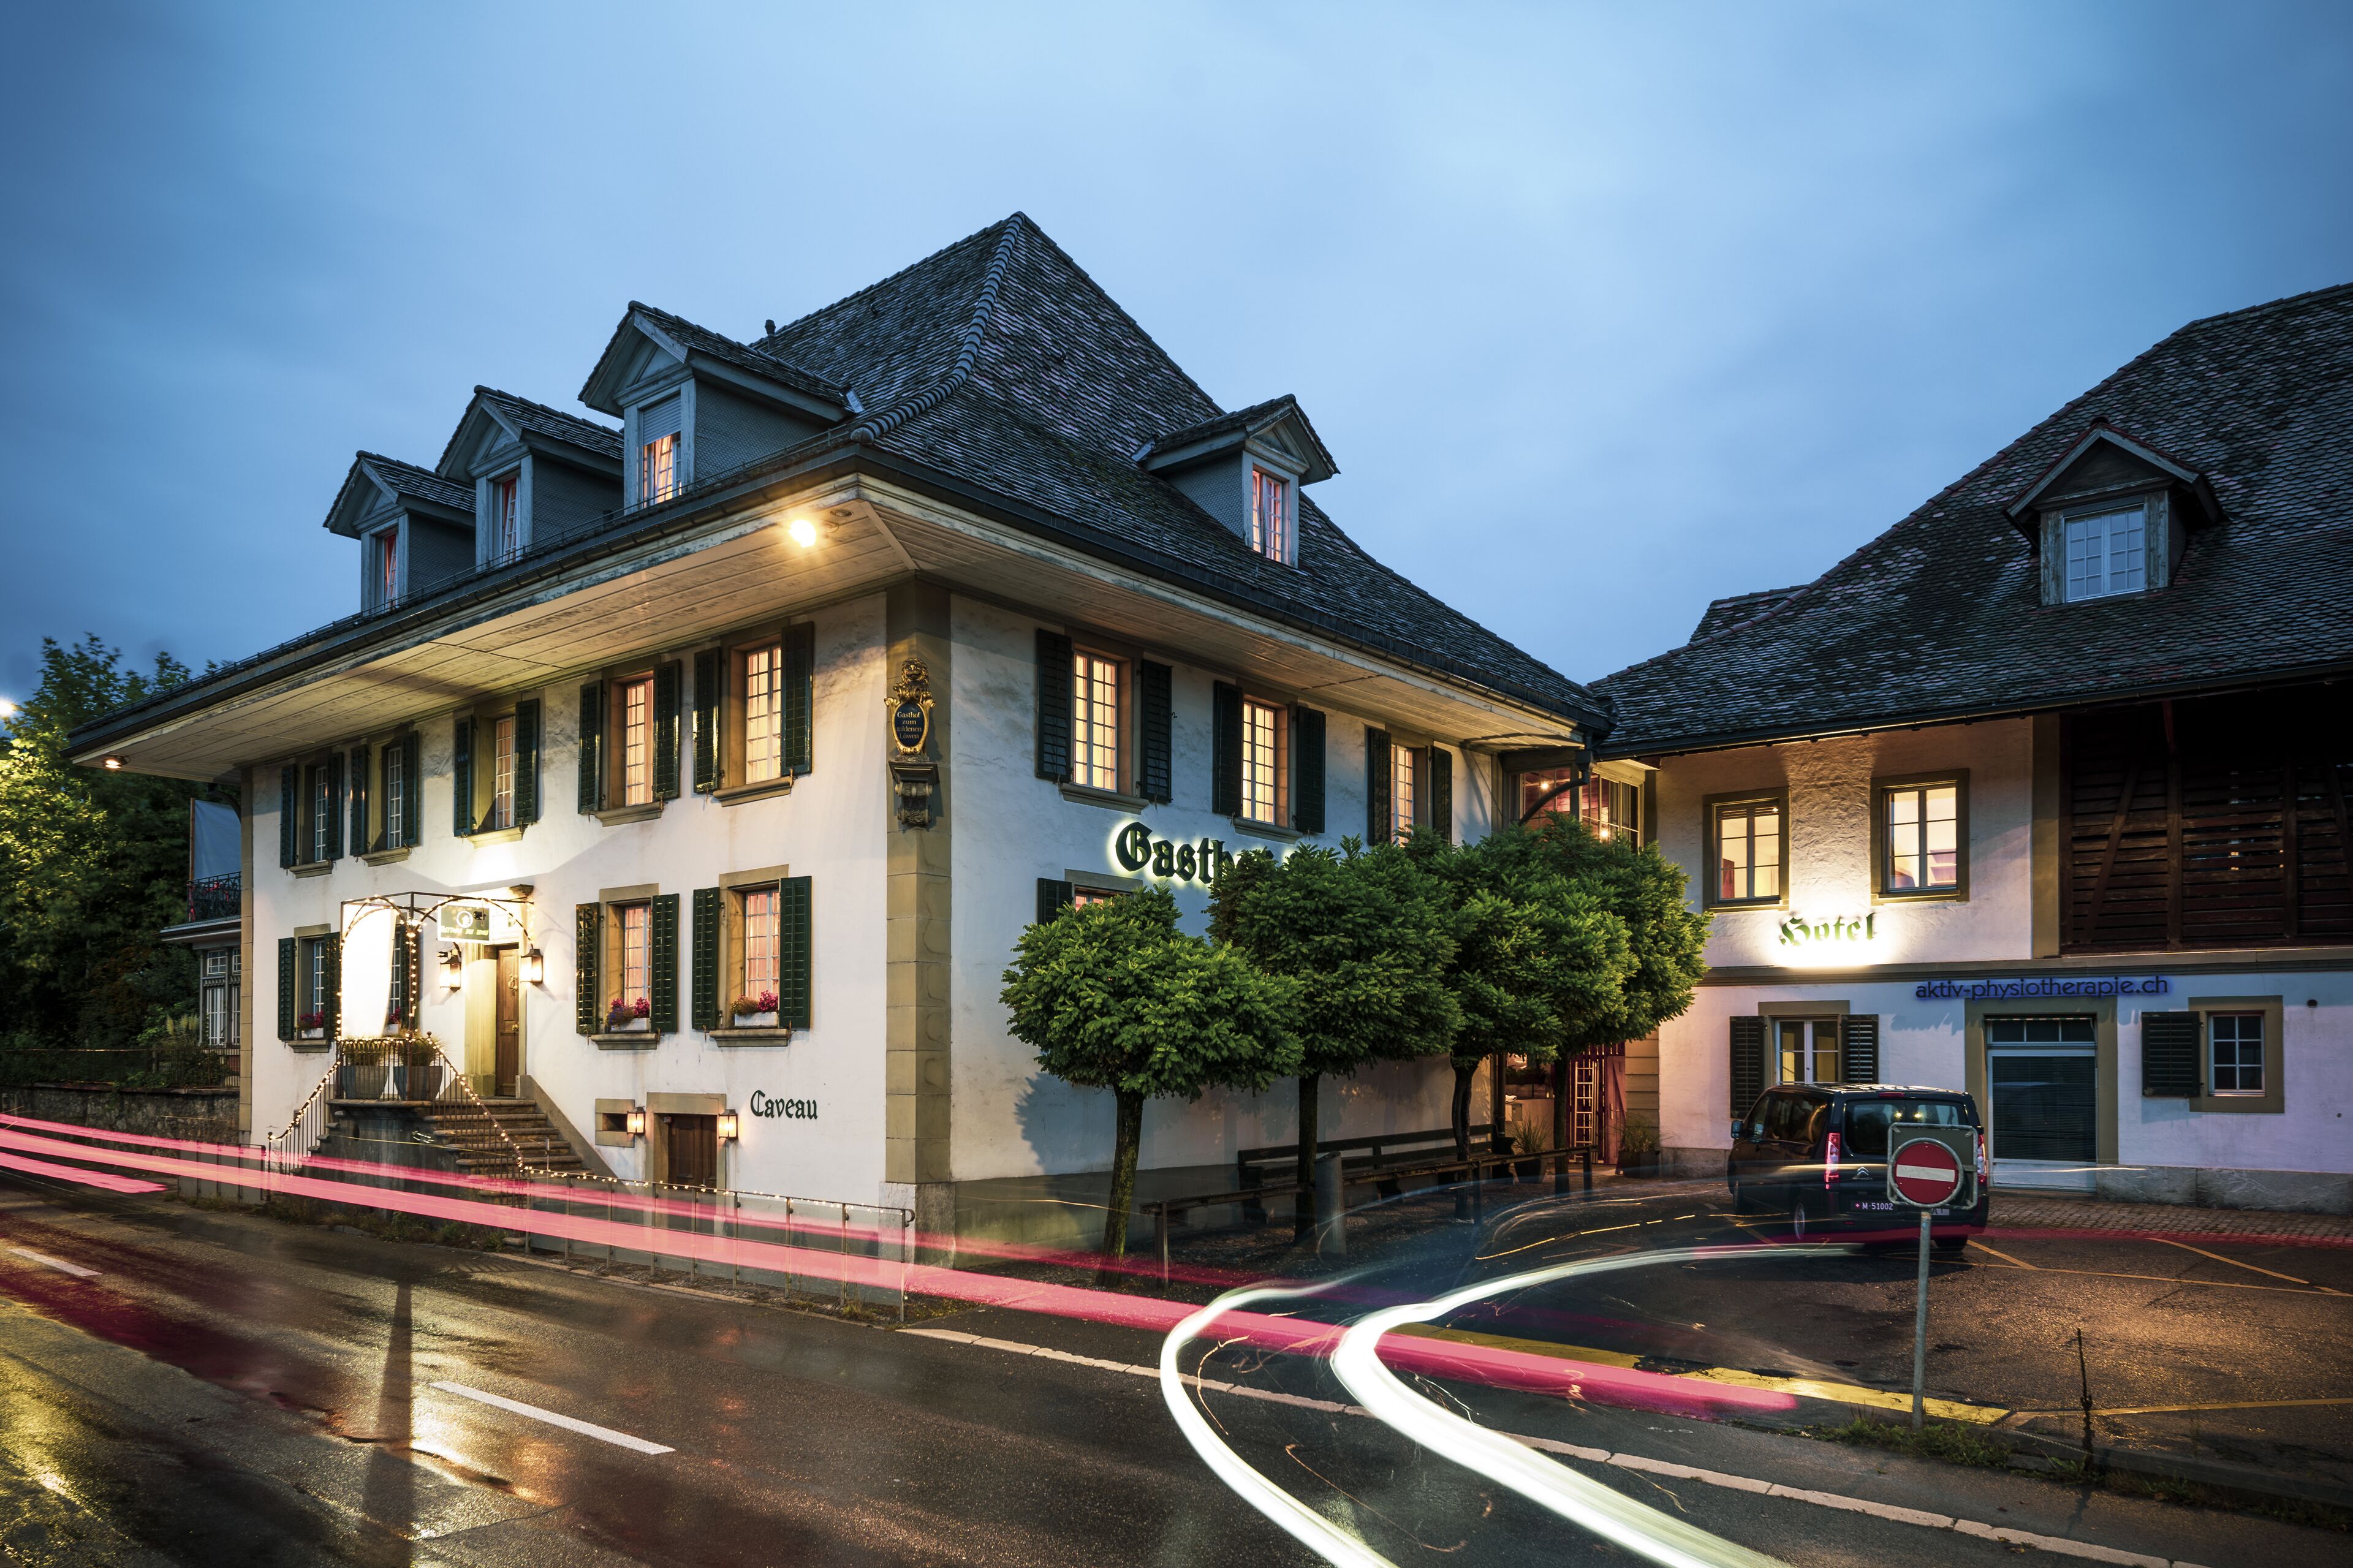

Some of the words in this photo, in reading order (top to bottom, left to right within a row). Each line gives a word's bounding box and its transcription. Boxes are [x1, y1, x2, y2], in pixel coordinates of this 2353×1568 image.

[1779, 912, 1877, 946] Hotel
[1915, 975, 2169, 1001] aktiv-physiotherapie.ch
[750, 1089, 818, 1120] Caveau
